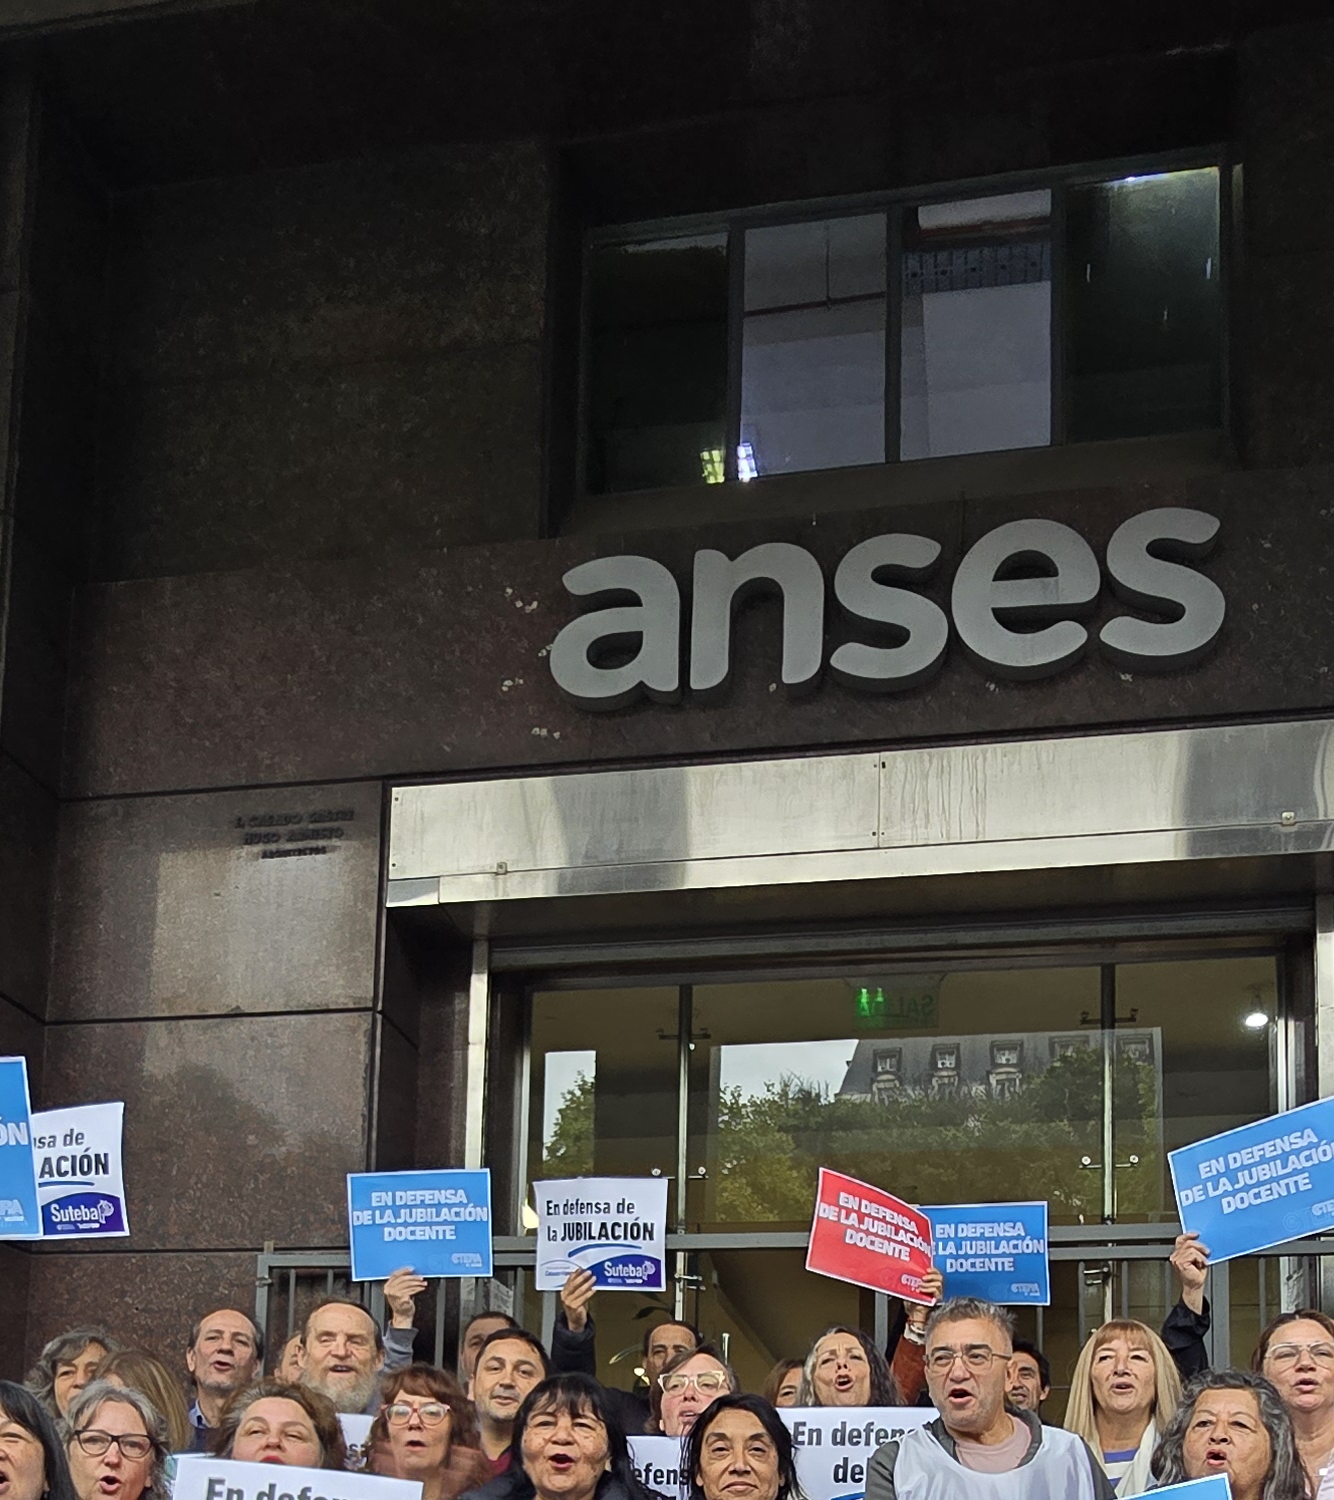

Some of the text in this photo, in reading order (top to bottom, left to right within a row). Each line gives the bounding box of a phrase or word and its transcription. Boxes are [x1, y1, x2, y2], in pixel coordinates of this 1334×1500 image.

[549, 506, 1225, 698] anses
[63, 1128, 84, 1148] de
[1198, 1127, 1319, 1180] EN DEFENSA
[371, 1189, 467, 1207] EN DEFENSA
[1180, 1184, 1206, 1207] DE
[1206, 1177, 1234, 1198] LA
[1221, 1172, 1313, 1215] DOCENTE
[51, 1202, 99, 1224] Suteba
[353, 1203, 488, 1226] DE LA JUBILACIÓN
[546, 1197, 635, 1217] En defensa de
[838, 1191, 919, 1235] EN DEFENSA
[384, 1224, 456, 1242] DOCENTE
[547, 1217, 655, 1242] la JUBILACIÓN
[818, 1201, 839, 1222] DE
[840, 1207, 862, 1226] LA
[860, 1216, 932, 1257] JUBILACIÓN
[935, 1222, 1025, 1238] EN DEFENSA
[845, 1229, 911, 1262] DOCENTE
[938, 1240, 956, 1255] LA
[957, 1235, 1044, 1255] JUBILACIÓN
[604, 1261, 644, 1279] Suteba
[946, 1258, 1014, 1273] DOCENTE
[793, 1421, 828, 1446] En
